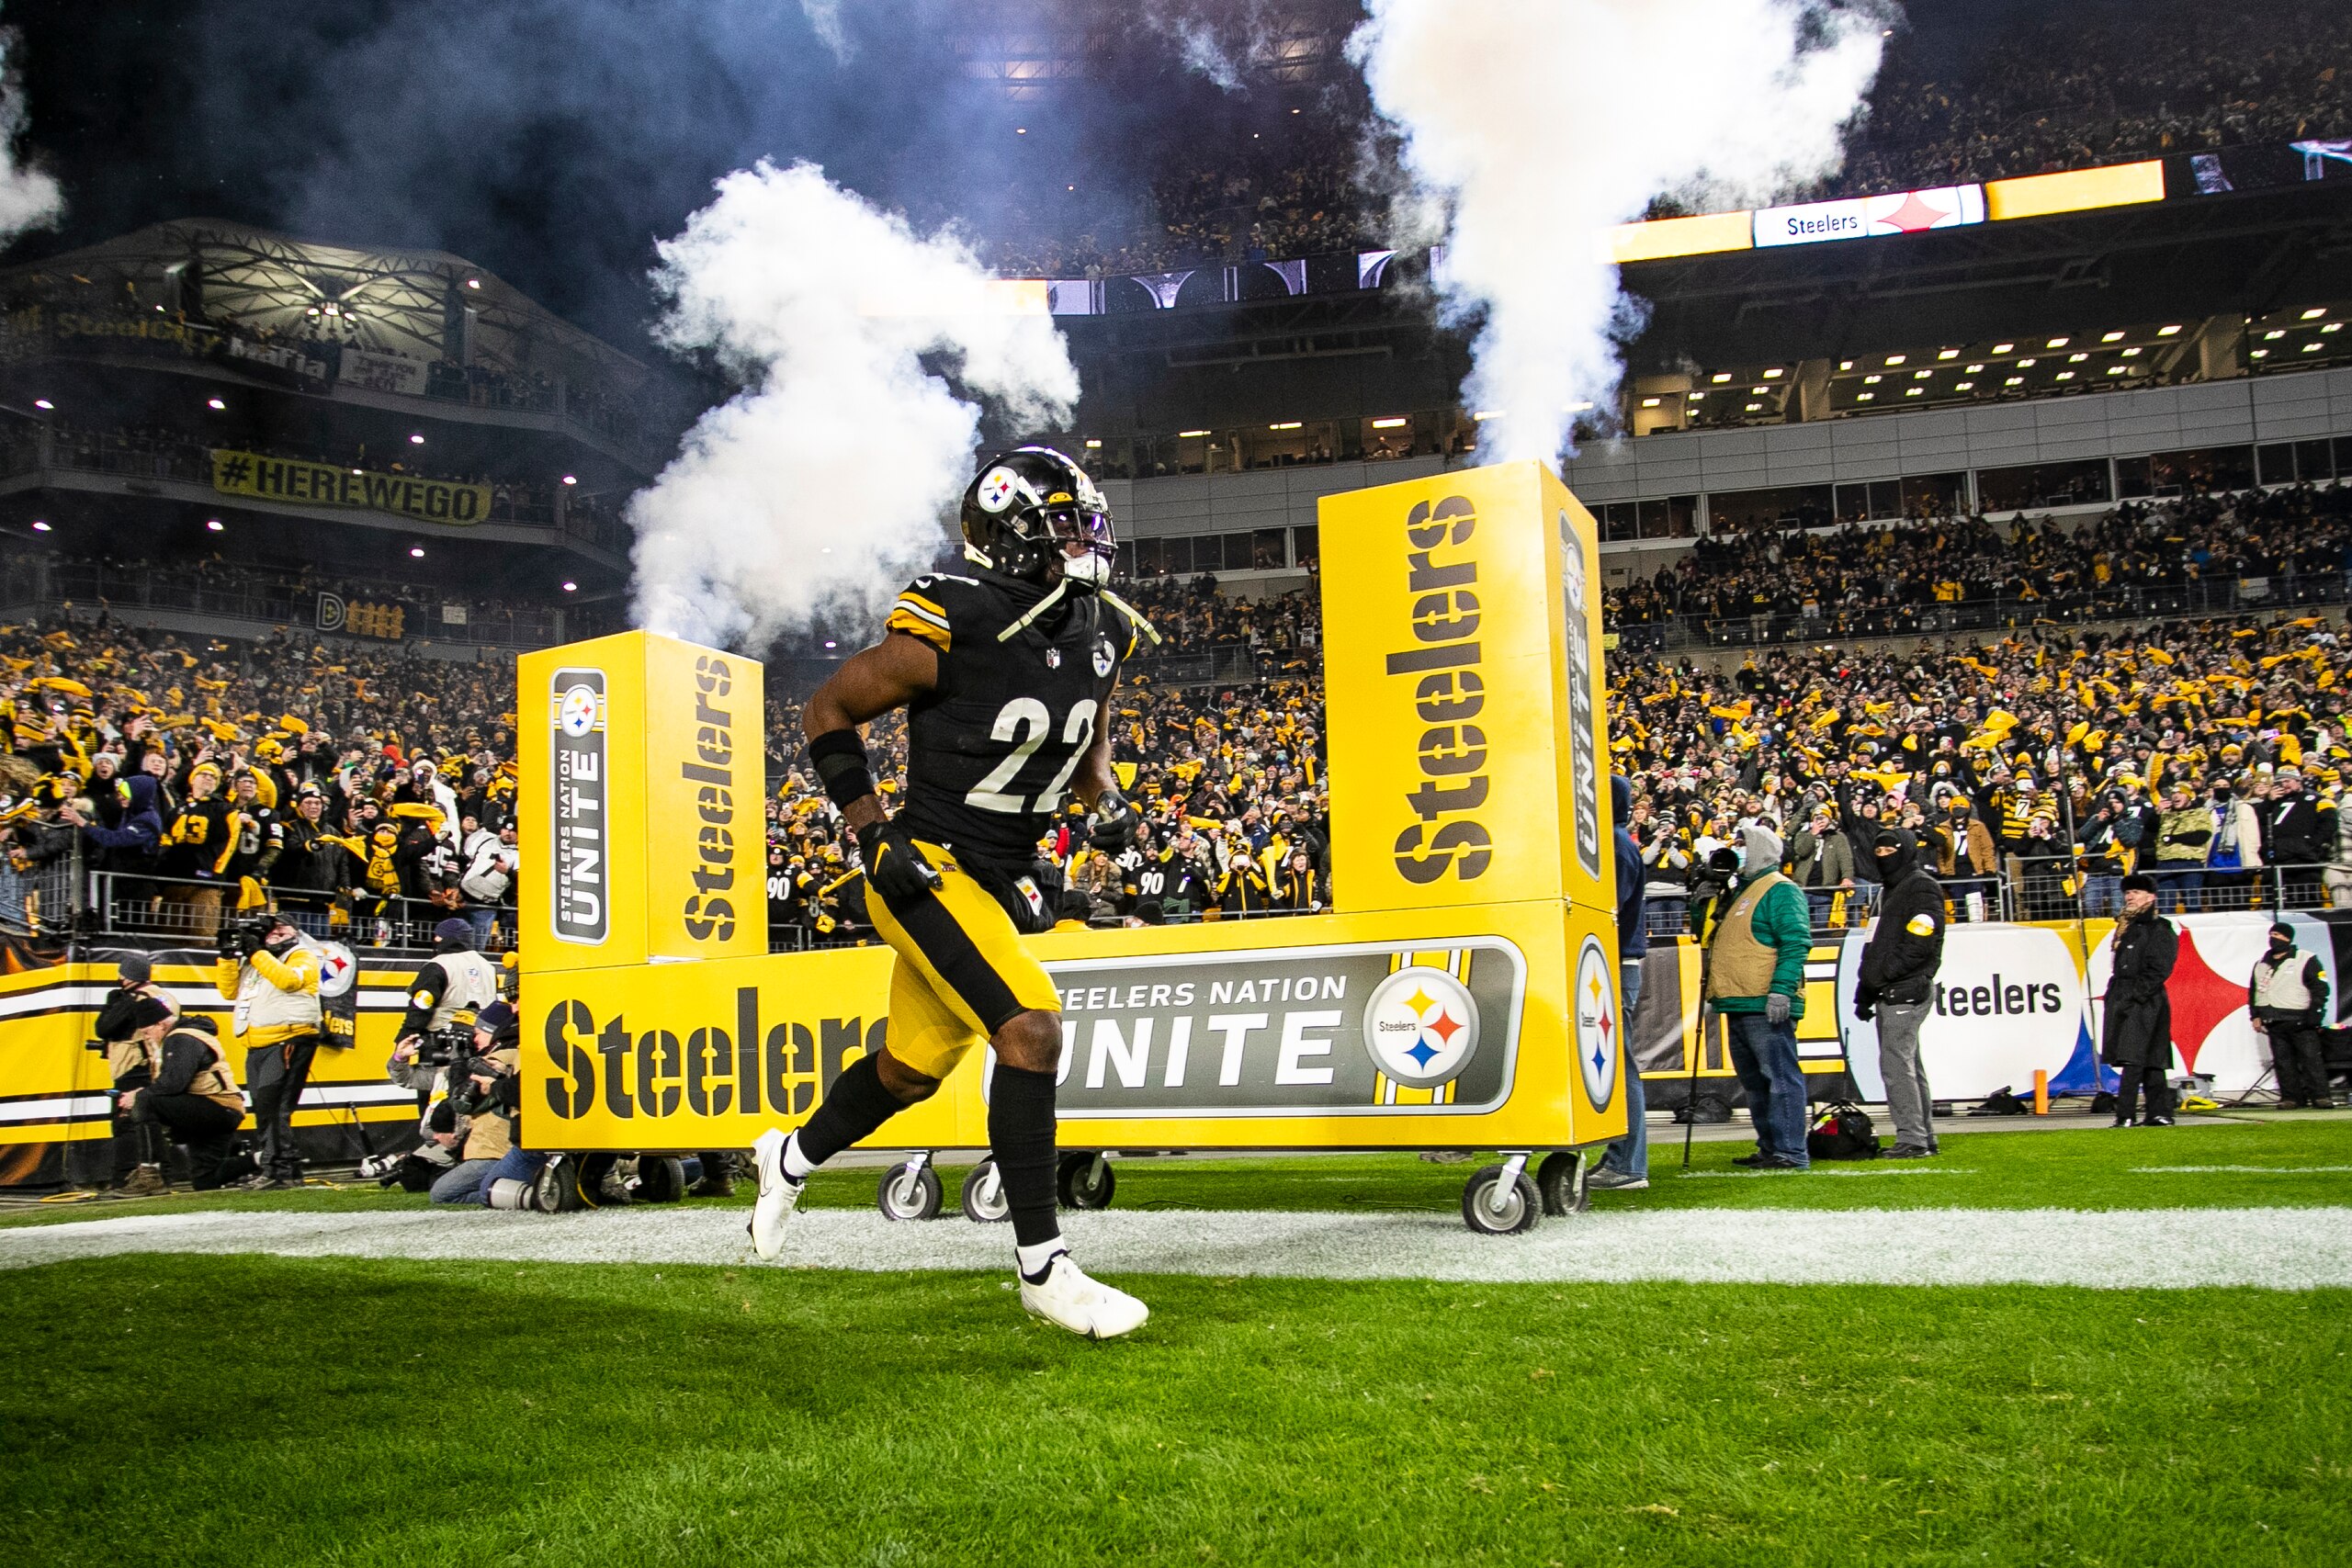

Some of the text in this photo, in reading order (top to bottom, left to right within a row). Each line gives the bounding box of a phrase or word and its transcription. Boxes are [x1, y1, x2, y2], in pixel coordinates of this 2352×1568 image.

[1788, 214, 1858, 235] Steelers
[1385, 494, 1494, 884] Steelers
[965, 698, 1097, 813] 22
[1573, 626, 1598, 855] UNITE
[682, 655, 735, 942] Steelers
[2274, 802, 2296, 825] 7
[172, 814, 209, 844] 43
[559, 749, 572, 924] STEELERS NATION
[571, 750, 601, 926] UNITE
[766, 877, 790, 900] 90
[1140, 872, 1164, 896] 90
[1058, 975, 1347, 1010] EELERS NATION
[1935, 974, 2062, 1016] teelers
[1379, 1021, 1416, 1032] Steelers
